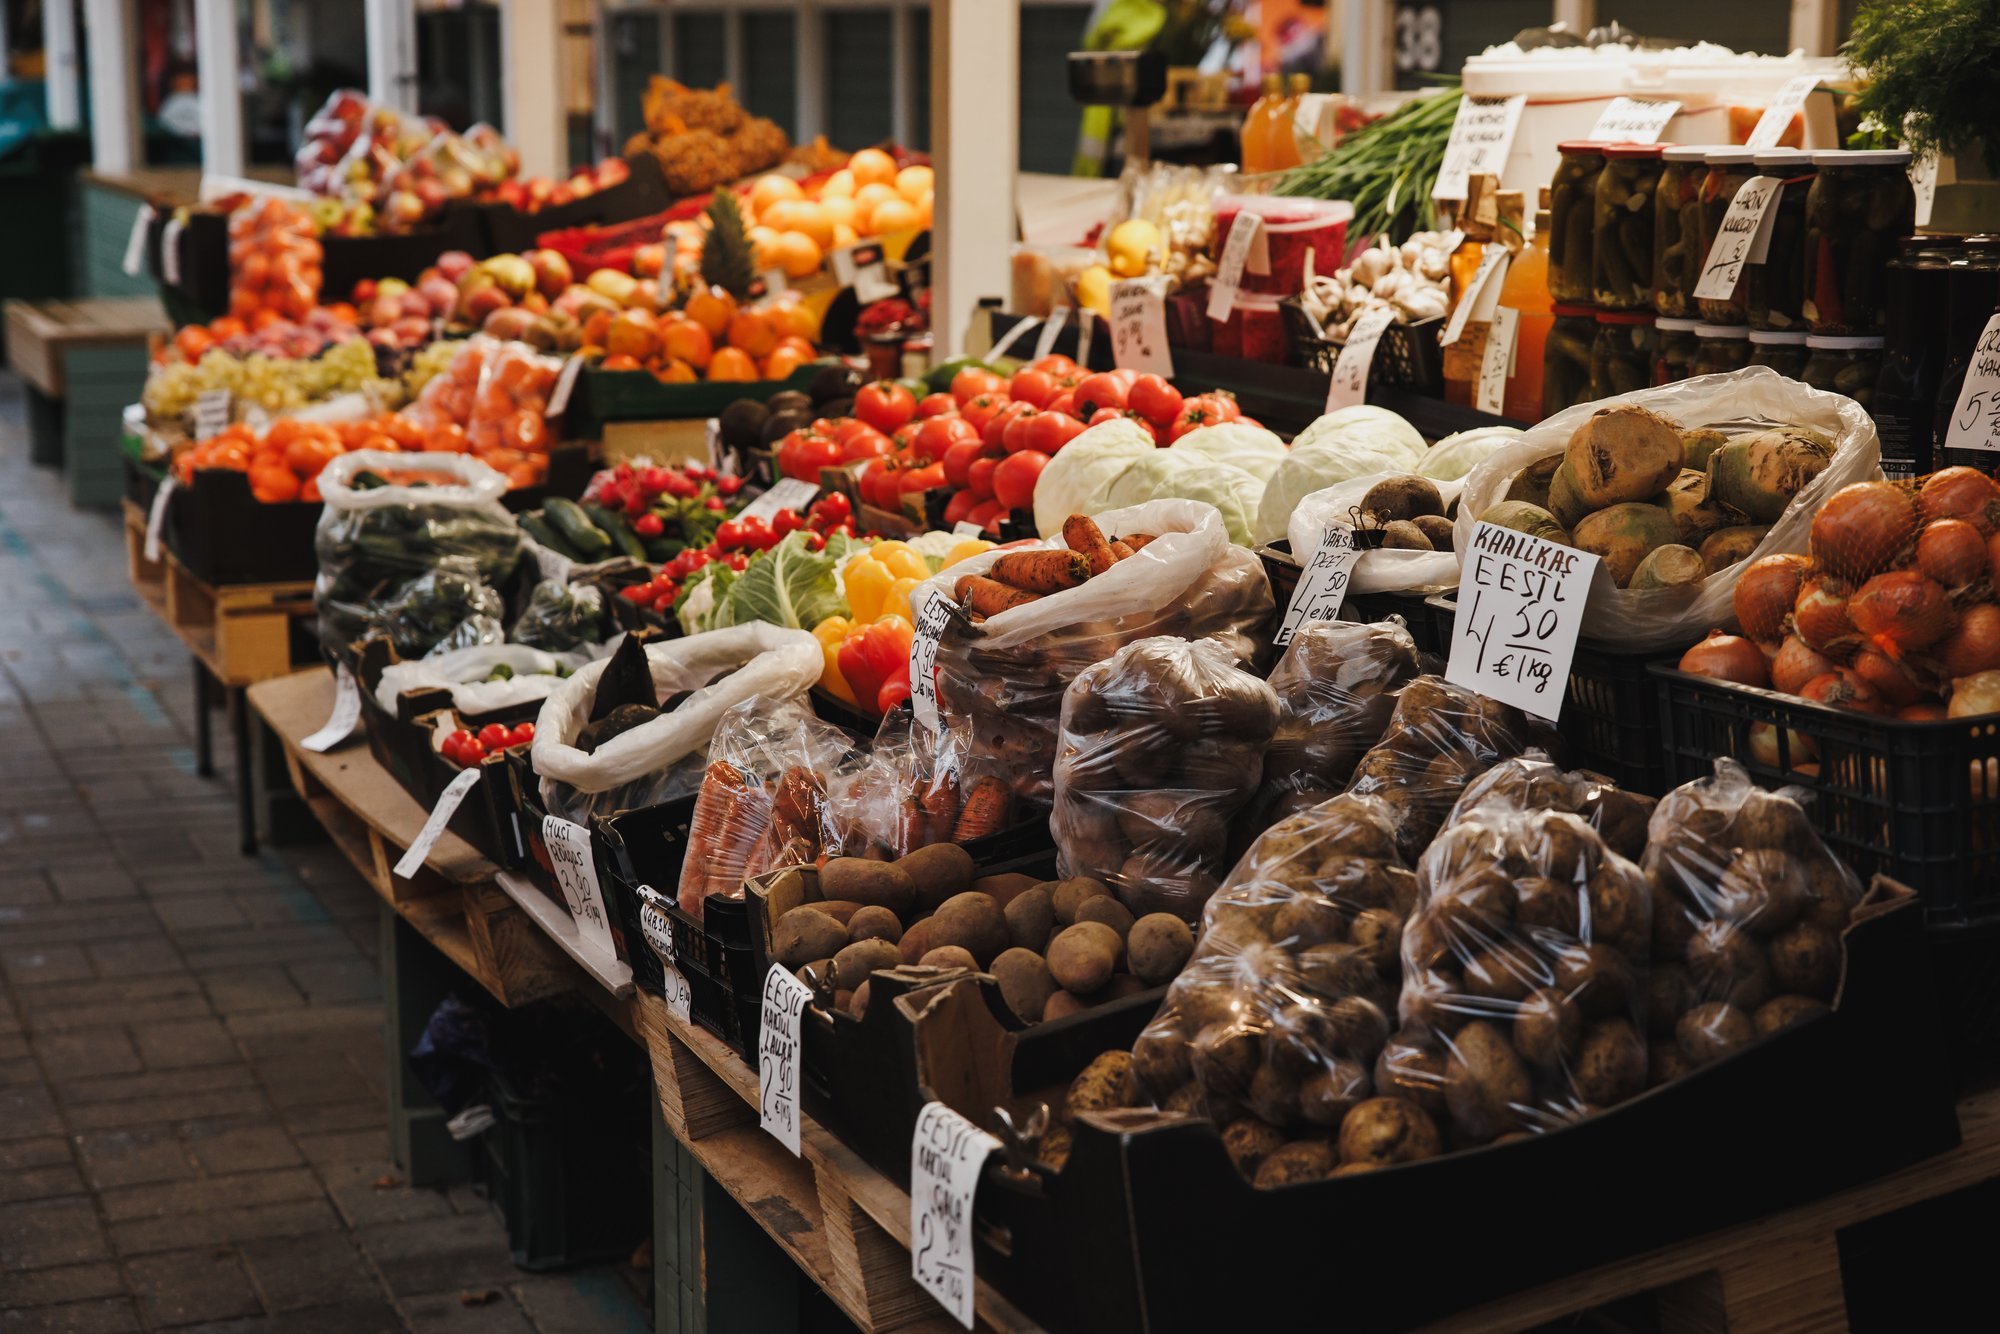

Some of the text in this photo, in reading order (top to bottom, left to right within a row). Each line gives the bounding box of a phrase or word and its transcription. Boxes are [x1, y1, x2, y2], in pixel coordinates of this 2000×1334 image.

[1395, 6, 1439, 70] 38
[1973, 358, 2000, 377] MAH
[1959, 390, 1989, 431] 5
[1322, 527, 1355, 550] VÄRSK
[1291, 571, 1347, 630] 4 50
[1475, 554, 1566, 602] EESTI
[1465, 589, 1559, 674] 4 50
[909, 639, 935, 694] 3 90
[561, 869, 583, 916] 3
[762, 1055, 793, 1122] 2 90
[918, 1212, 934, 1283] 2
